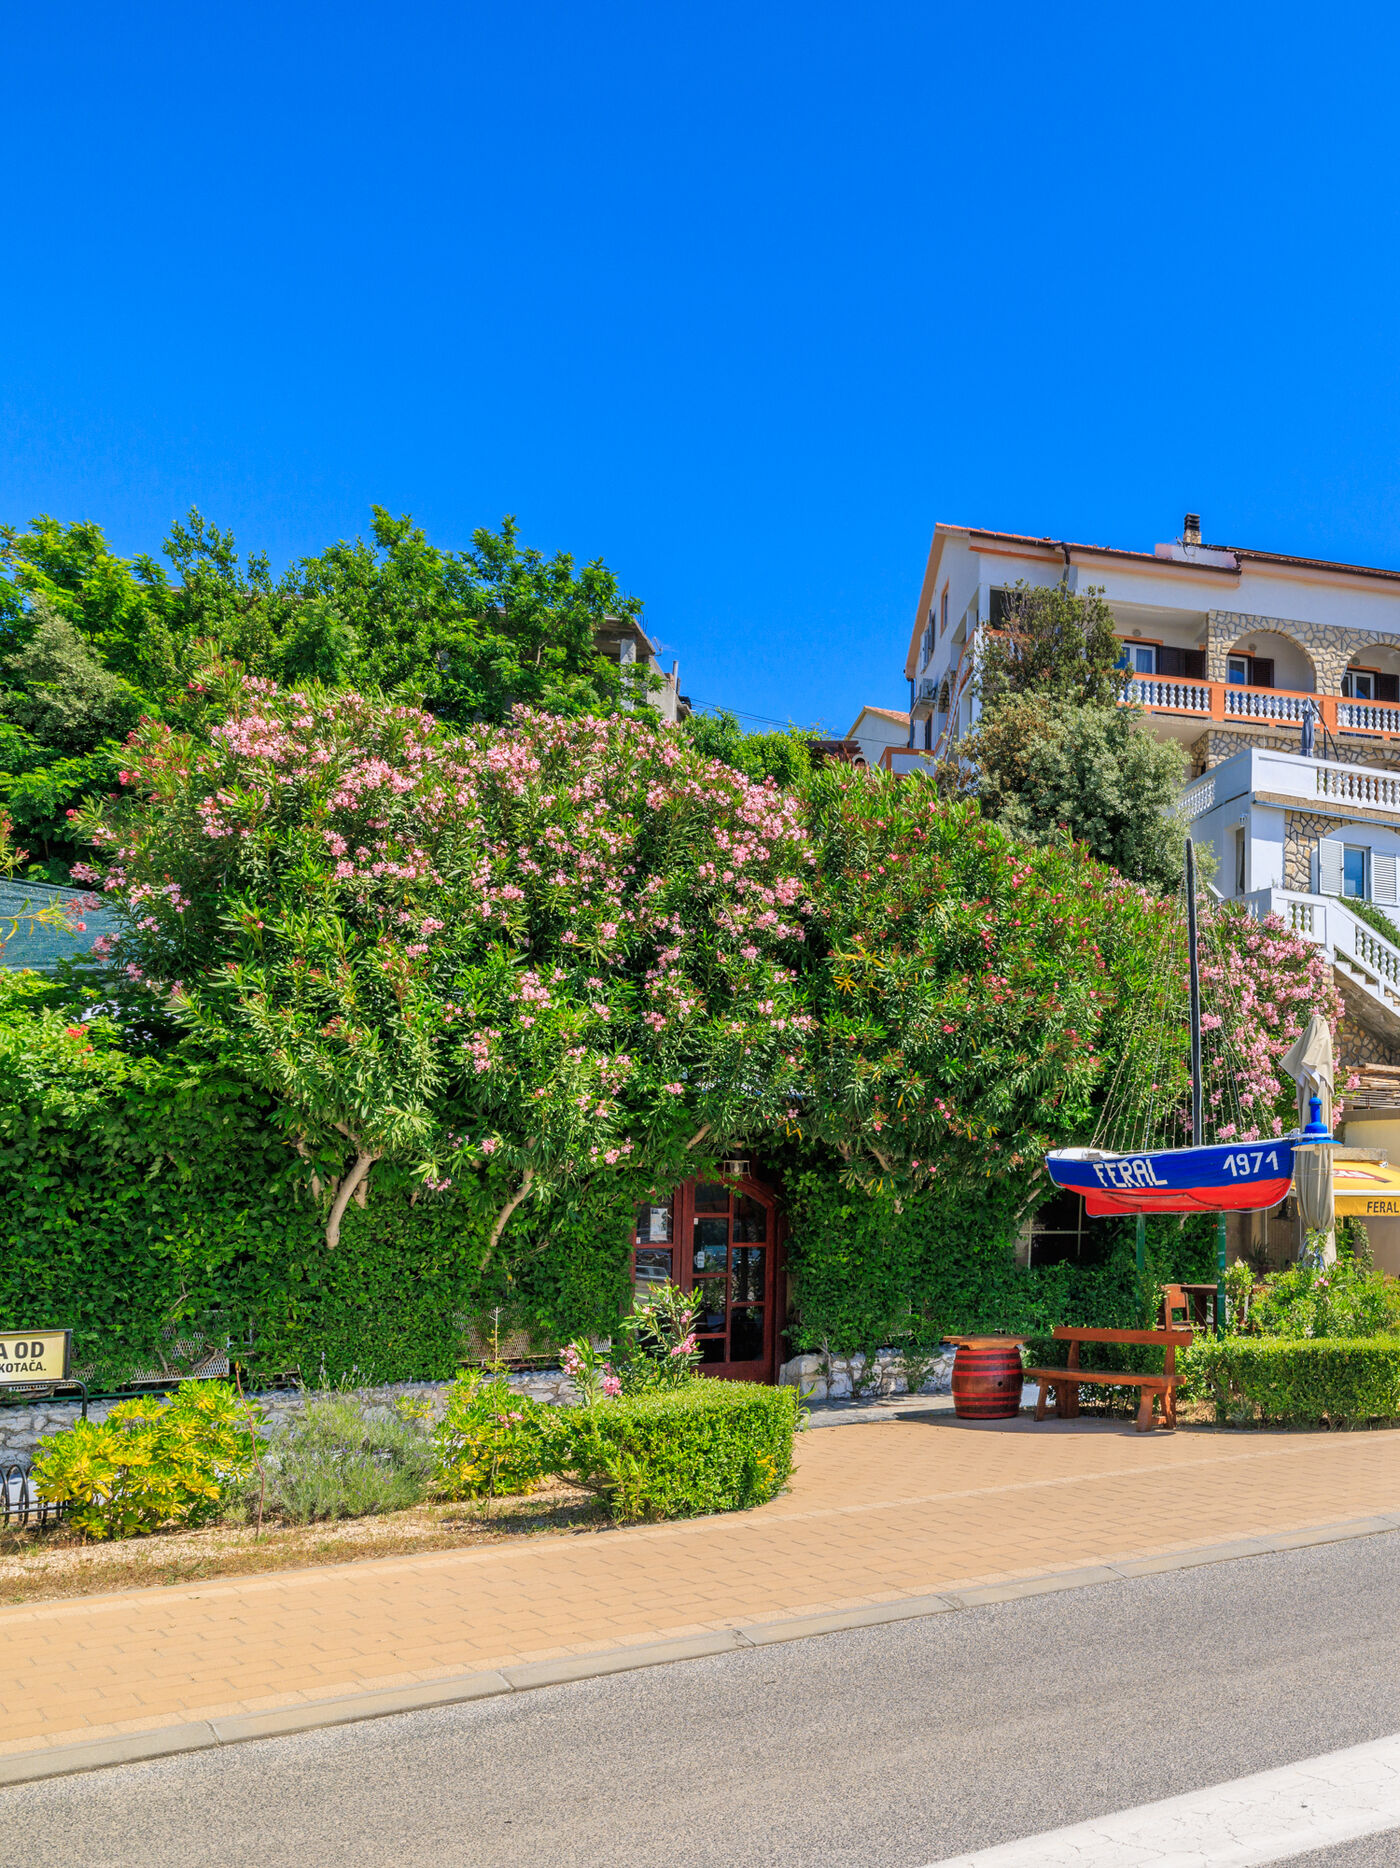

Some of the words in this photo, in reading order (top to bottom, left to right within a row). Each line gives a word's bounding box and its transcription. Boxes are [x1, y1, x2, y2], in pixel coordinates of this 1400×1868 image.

[1093, 1159, 1168, 1187] FERAL
[1222, 1150, 1279, 1177] 1971
[1366, 1201, 1400, 1213] FERAL
[14, 1341, 45, 1359] OD
